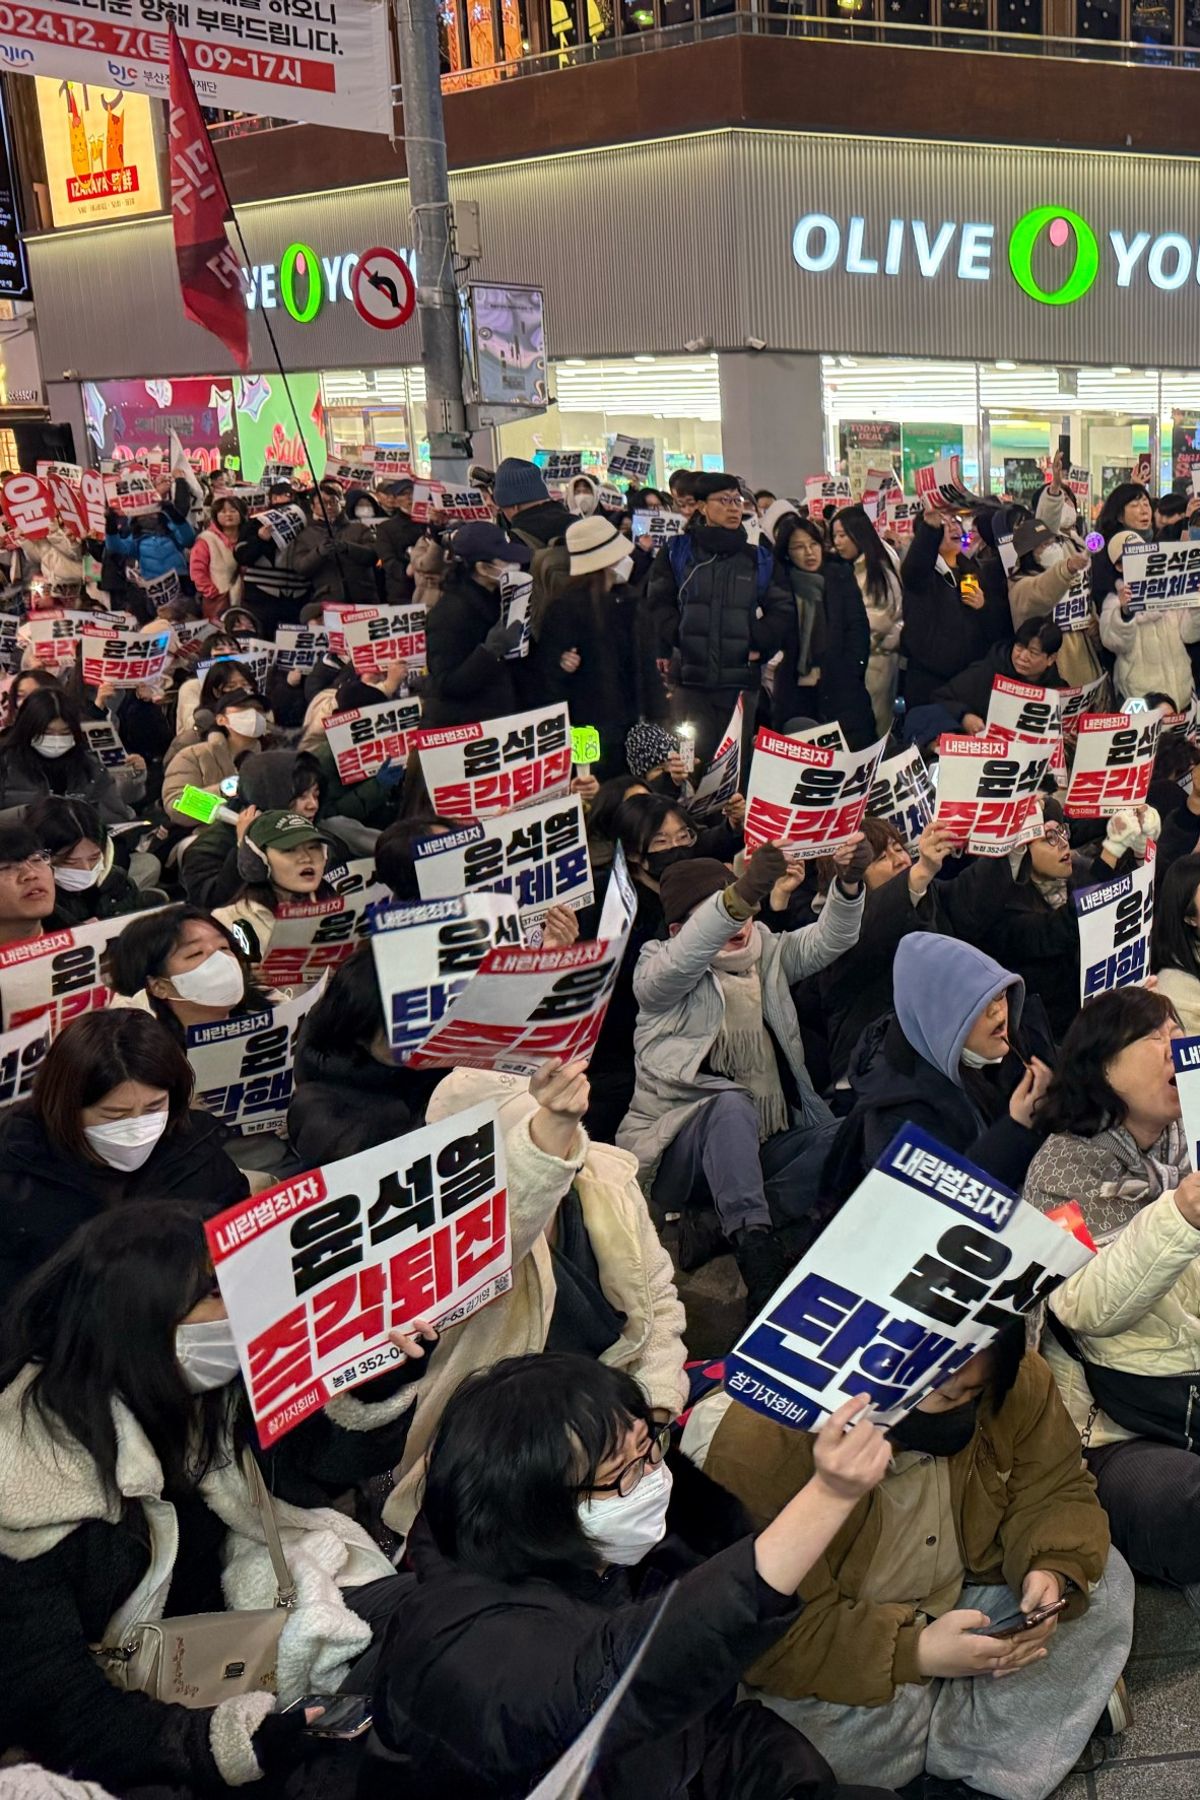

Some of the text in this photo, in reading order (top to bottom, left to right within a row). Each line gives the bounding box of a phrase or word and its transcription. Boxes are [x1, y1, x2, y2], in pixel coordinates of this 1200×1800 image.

[196, 8, 344, 55] 부탁드립니다.
[195, 44, 303, 84] 09~17시
[792, 213, 996, 280] OLIVE
[850, 422, 891, 434] TODAY'S
[1006, 481, 1045, 491] CHANC
[294, 632, 329, 649] 윤석
[368, 610, 426, 641] 윤석열
[996, 680, 1045, 698] 내란범죄자
[350, 702, 420, 745] 윤석열
[421, 725, 481, 747] 내란범죄자
[1083, 715, 1130, 730] 내란범죄자
[1105, 721, 1162, 767] 윤석
[463, 712, 567, 779] 윤석열
[761, 735, 831, 766] 내란범죄자
[945, 740, 1007, 757] 내란범죄자
[434, 750, 571, 817] 즉각퇴진
[789, 754, 879, 808] 윤석
[975, 757, 1050, 799] 윤석
[1065, 760, 1153, 804] 즉각퇴
[744, 796, 868, 848] 즉각퇴
[937, 795, 1038, 840] 즉각퇴
[417, 825, 482, 857] 내란범죄자
[463, 805, 580, 889] 윤석열
[1080, 878, 1131, 911] 내란범죄자
[0, 930, 71, 964] 내란범죄자
[490, 941, 602, 973] 내란범죄자
[1084, 935, 1147, 997] 탄핵
[194, 1012, 270, 1044] 내란범죄자
[198, 1067, 296, 1126] 탄핵
[891, 1142, 1014, 1226] 내란범죄자
[215, 1176, 320, 1254] 내란범죄자
[289, 1119, 497, 1298] 윤석열
[889, 1223, 1067, 1328] 윤석
[246, 1187, 508, 1416] 즉각퇴진
[267, 1287, 492, 1436] 참가자회비 농협 김기영
[736, 1271, 976, 1413] 탄핵
[728, 1370, 809, 1424] 참가자회비
